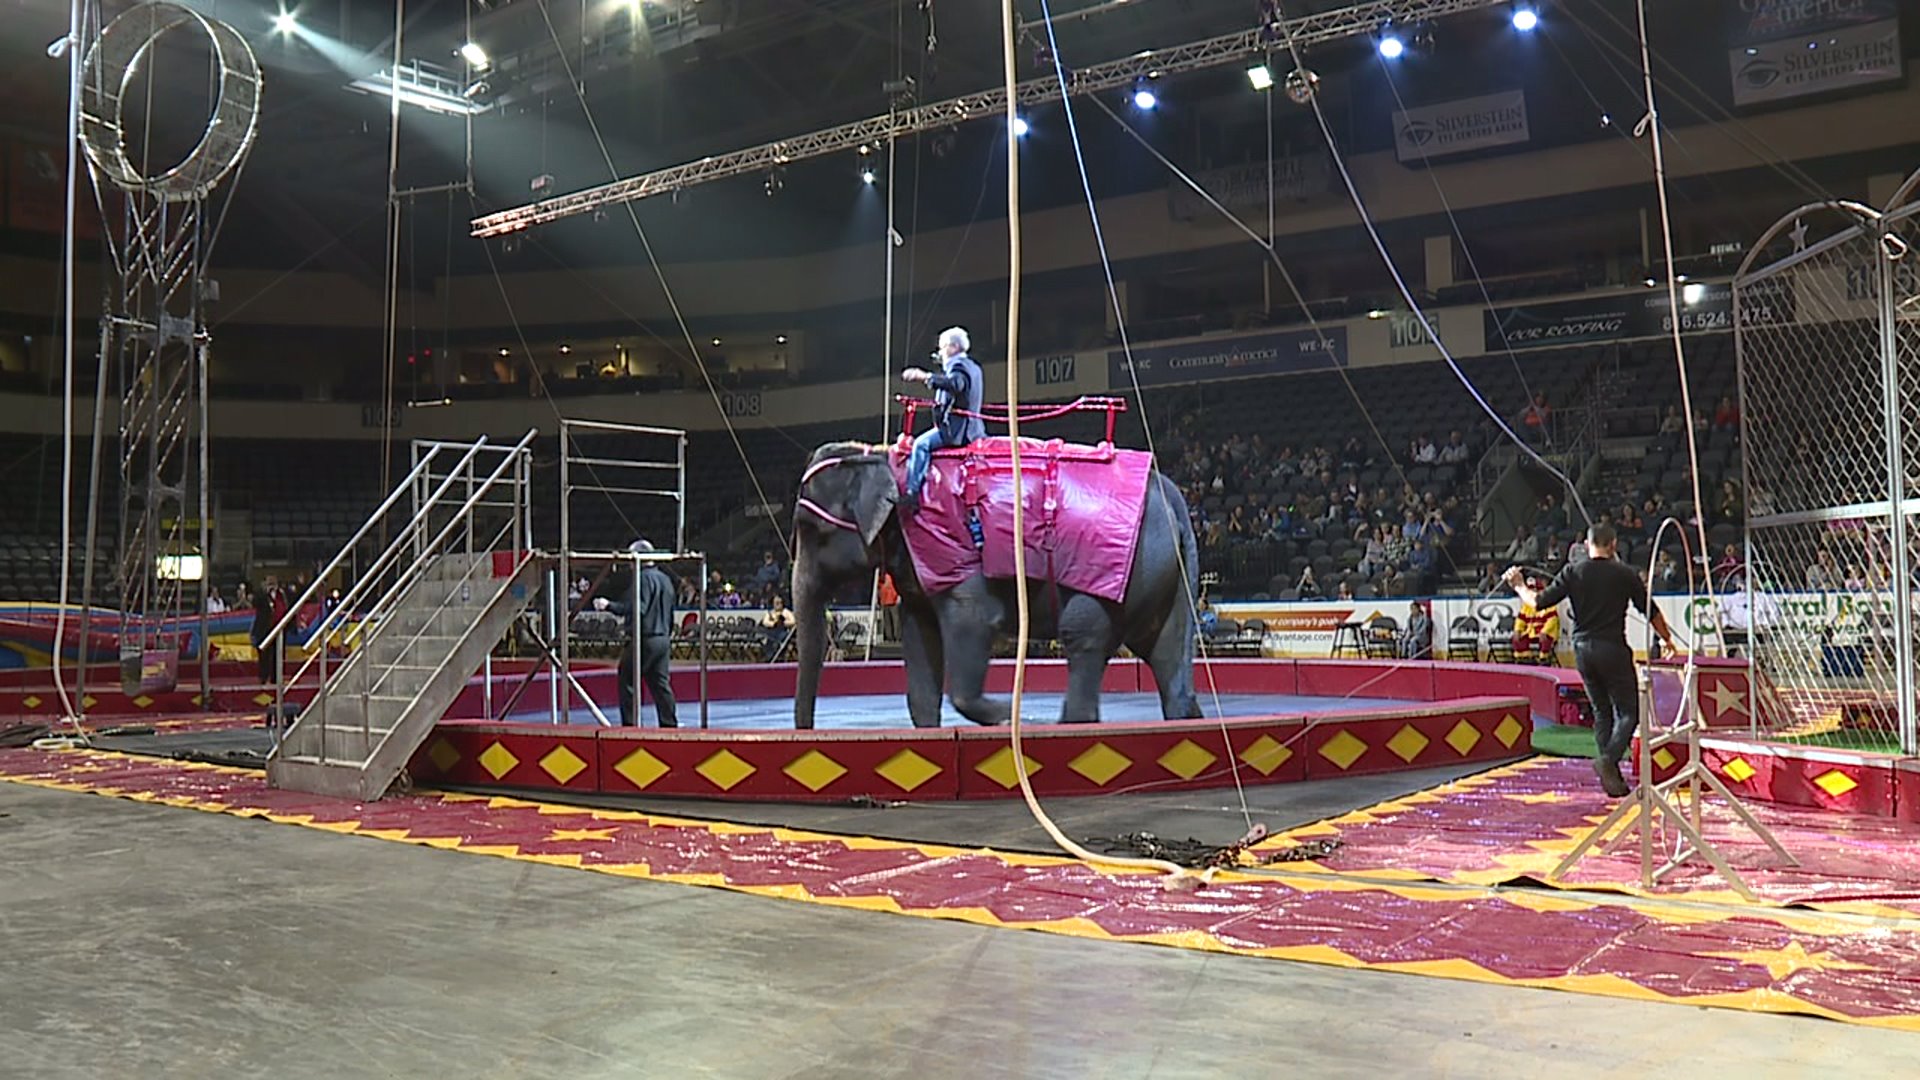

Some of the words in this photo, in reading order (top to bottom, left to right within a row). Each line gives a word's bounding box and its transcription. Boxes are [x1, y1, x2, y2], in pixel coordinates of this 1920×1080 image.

[1435, 104, 1522, 132] SILVERSTEIN
[1037, 357, 1074, 382] 107
[722, 395, 760, 415] 108
